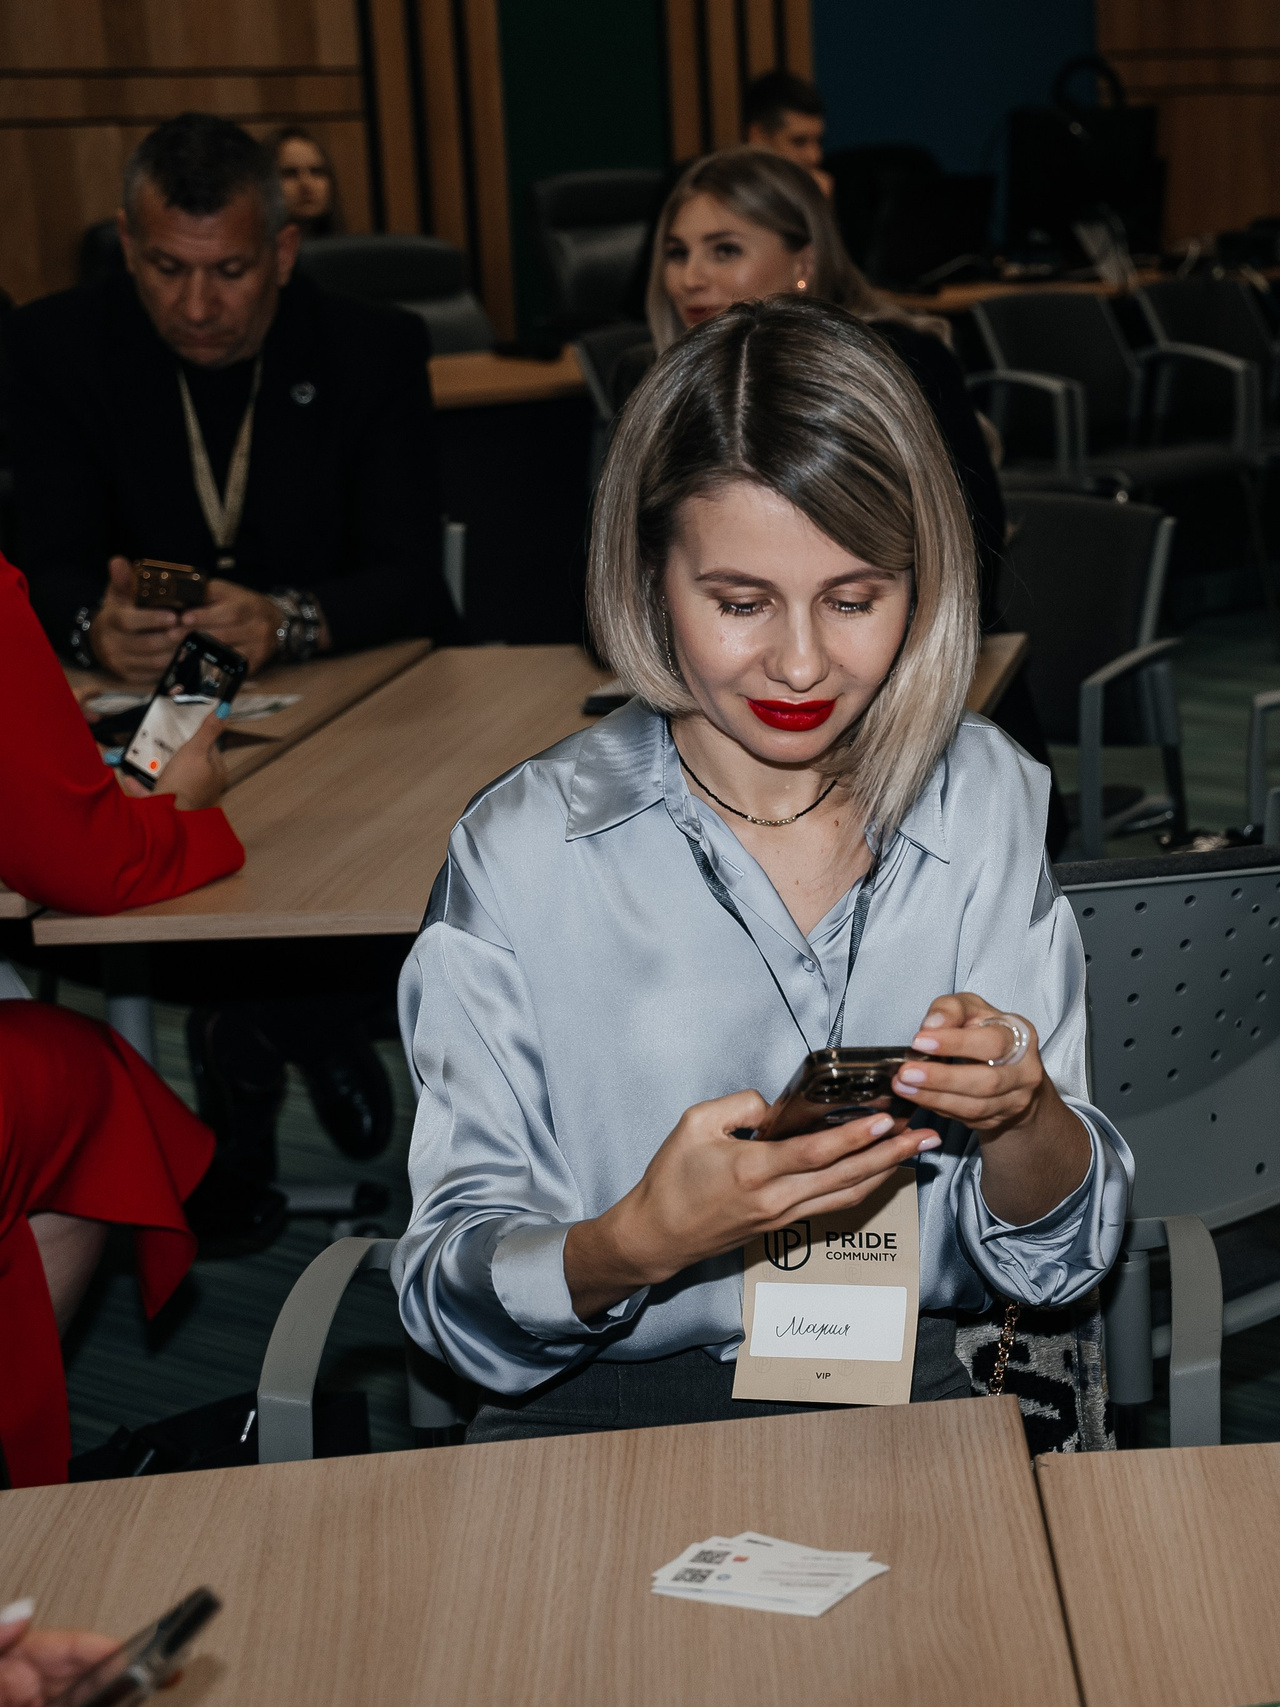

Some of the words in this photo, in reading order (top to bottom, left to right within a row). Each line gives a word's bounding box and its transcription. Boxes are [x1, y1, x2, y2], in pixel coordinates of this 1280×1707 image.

[825, 1231, 898, 1250] PRIDE
[825, 1251, 898, 1263] COMMUNITY
[775, 1316, 851, 1341] Мария
[815, 1372, 832, 1380] VIP
